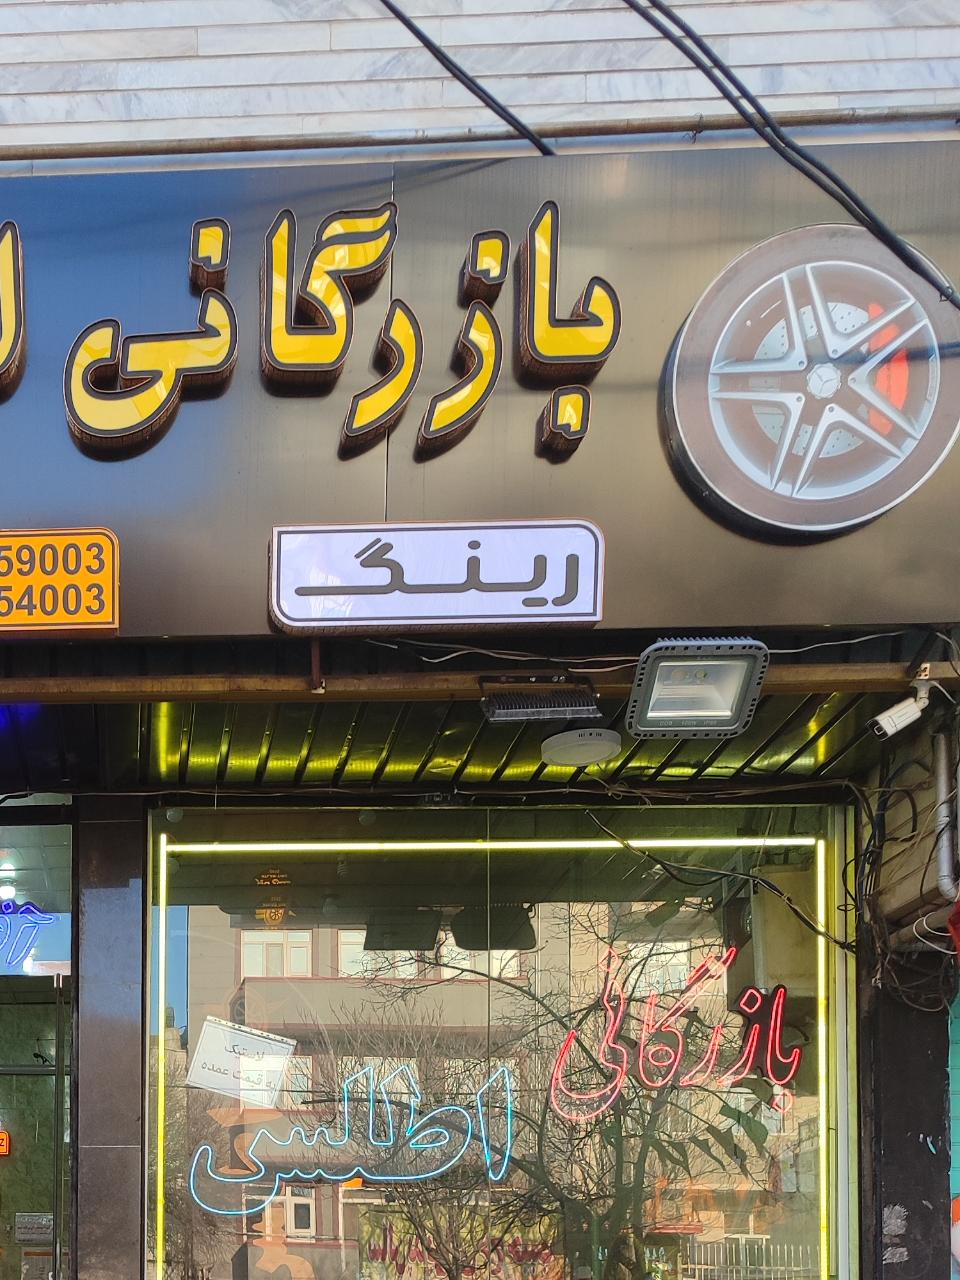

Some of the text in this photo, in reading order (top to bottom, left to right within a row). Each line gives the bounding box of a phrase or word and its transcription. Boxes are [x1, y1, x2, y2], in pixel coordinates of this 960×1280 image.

[62, 200, 621, 439] بازرگانی
[294, 538, 580, 607] رینگ
[551, 946, 803, 1121] بازرگانی
[190, 1066, 514, 1215] اطلس
